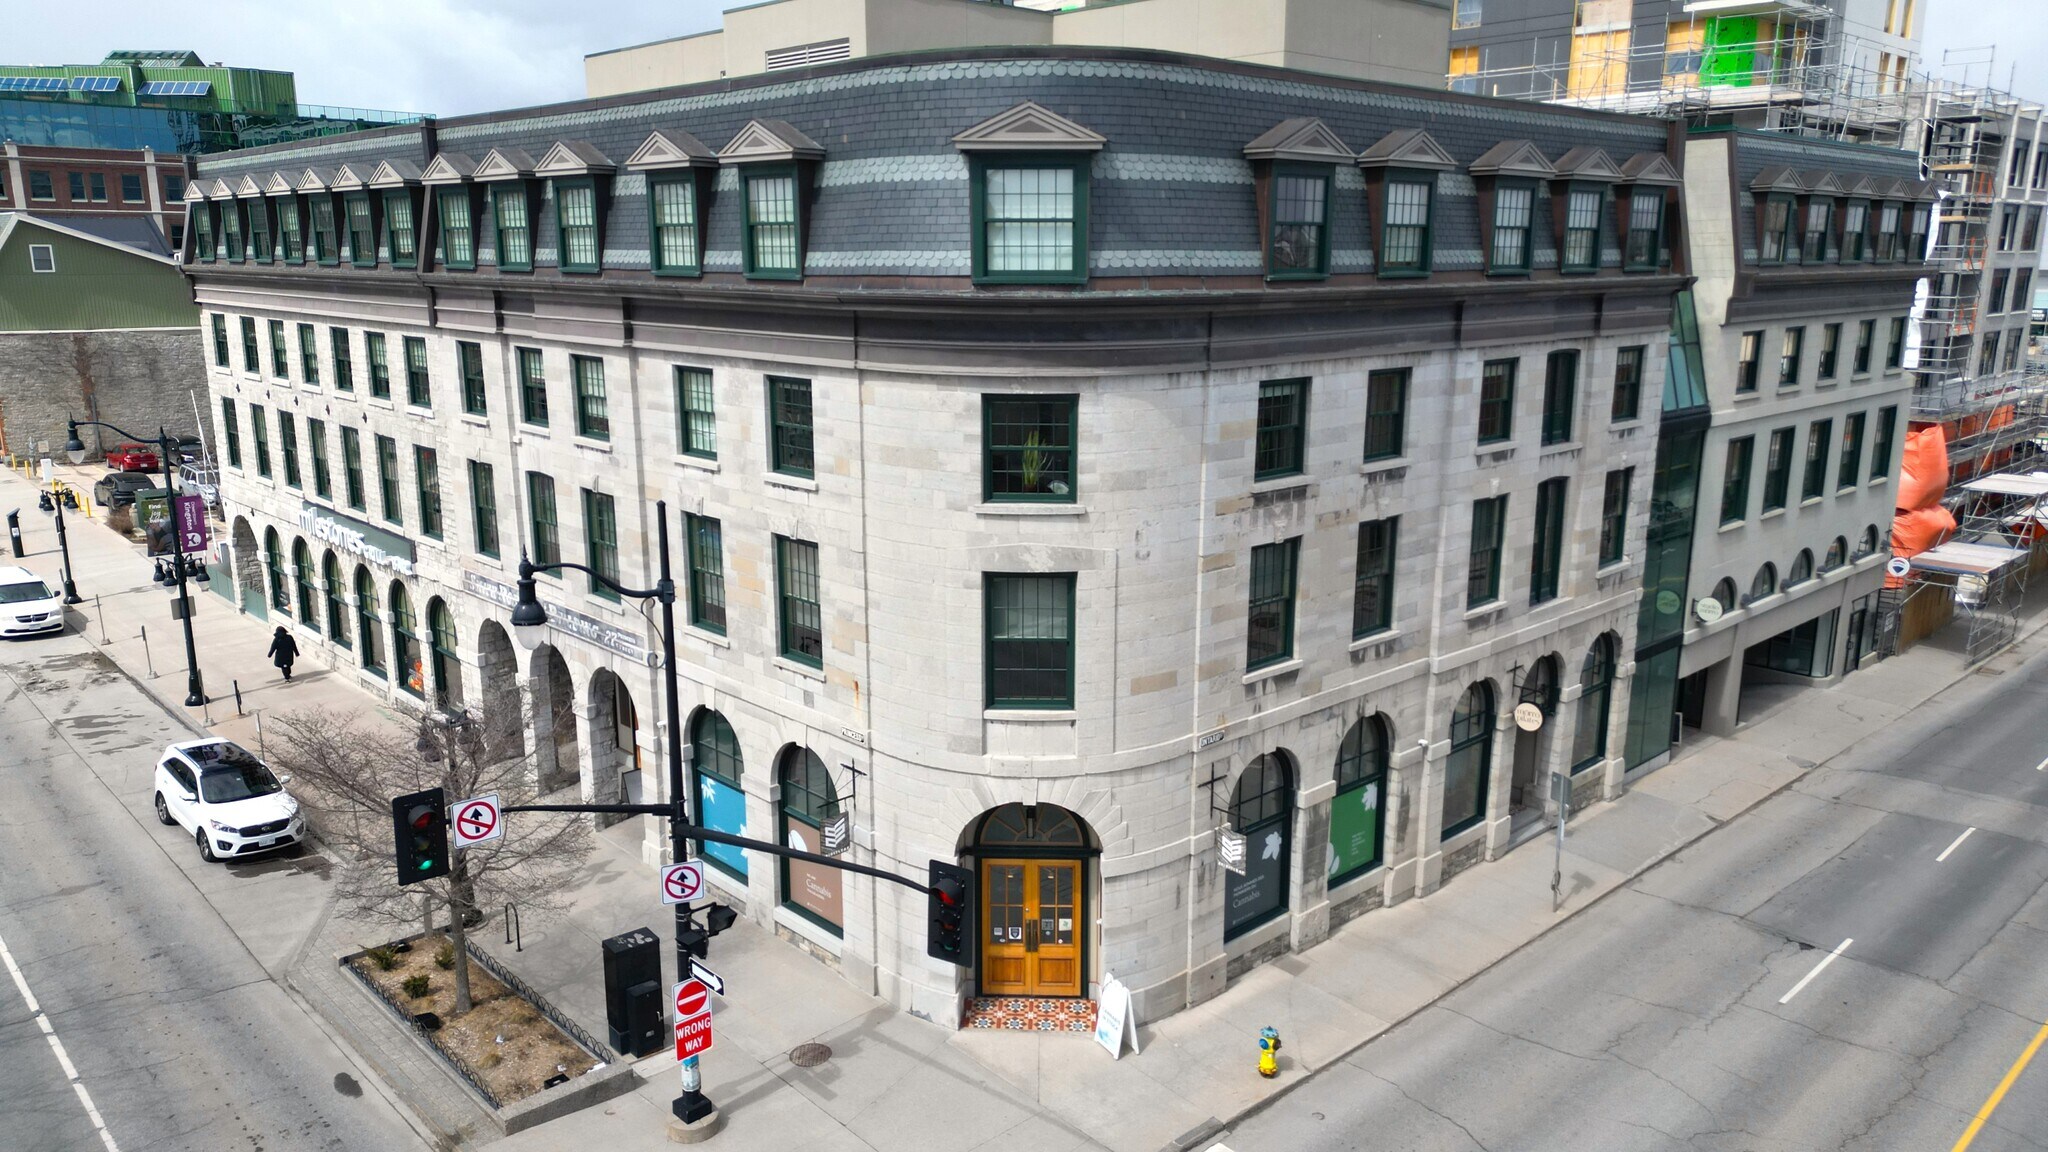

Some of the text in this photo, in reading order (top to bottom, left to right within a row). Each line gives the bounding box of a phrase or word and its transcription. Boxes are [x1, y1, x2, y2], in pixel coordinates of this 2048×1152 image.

[184, 502, 193, 530] Kingston
[299, 507, 365, 555] milestones
[806, 878, 832, 899] Cannabis
[676, 1016, 711, 1040] WRONG
[684, 1035, 704, 1053] WAY
